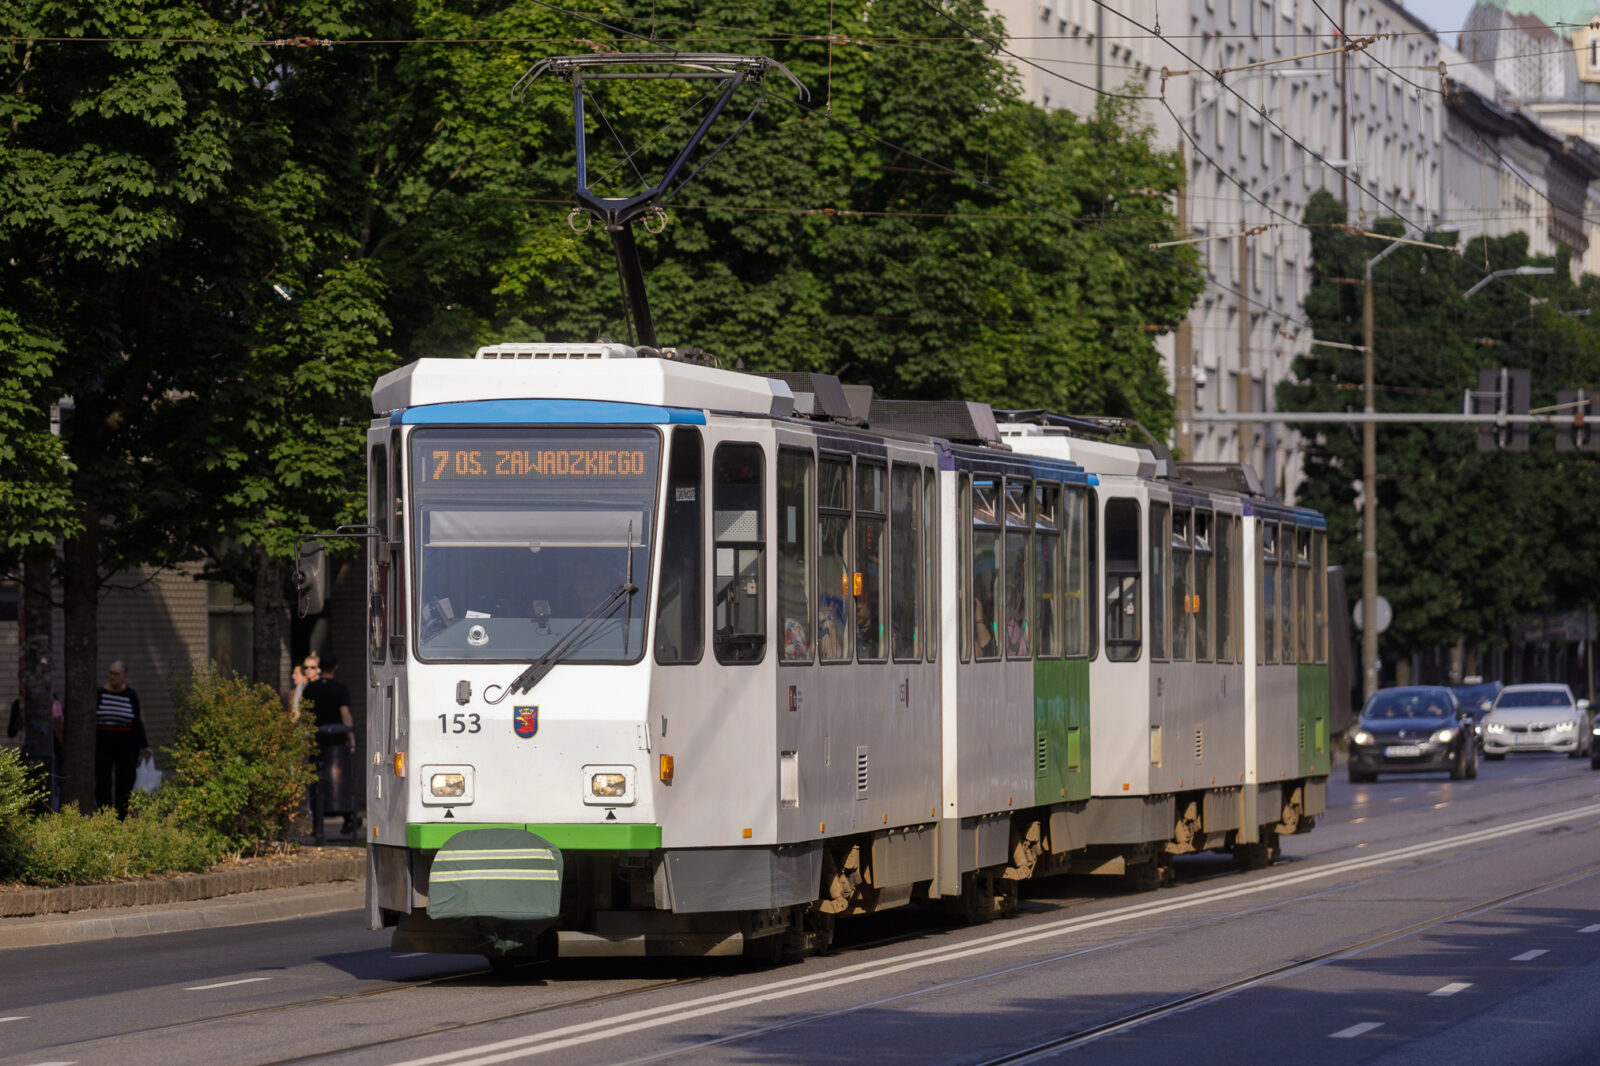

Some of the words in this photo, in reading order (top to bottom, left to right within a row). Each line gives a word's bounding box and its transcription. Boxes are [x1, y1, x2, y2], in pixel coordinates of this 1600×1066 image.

[432, 450, 449, 480] 7
[455, 451, 487, 475] OS.
[495, 451, 644, 475] ZAWADZKIEGO
[438, 713, 482, 734] 153
